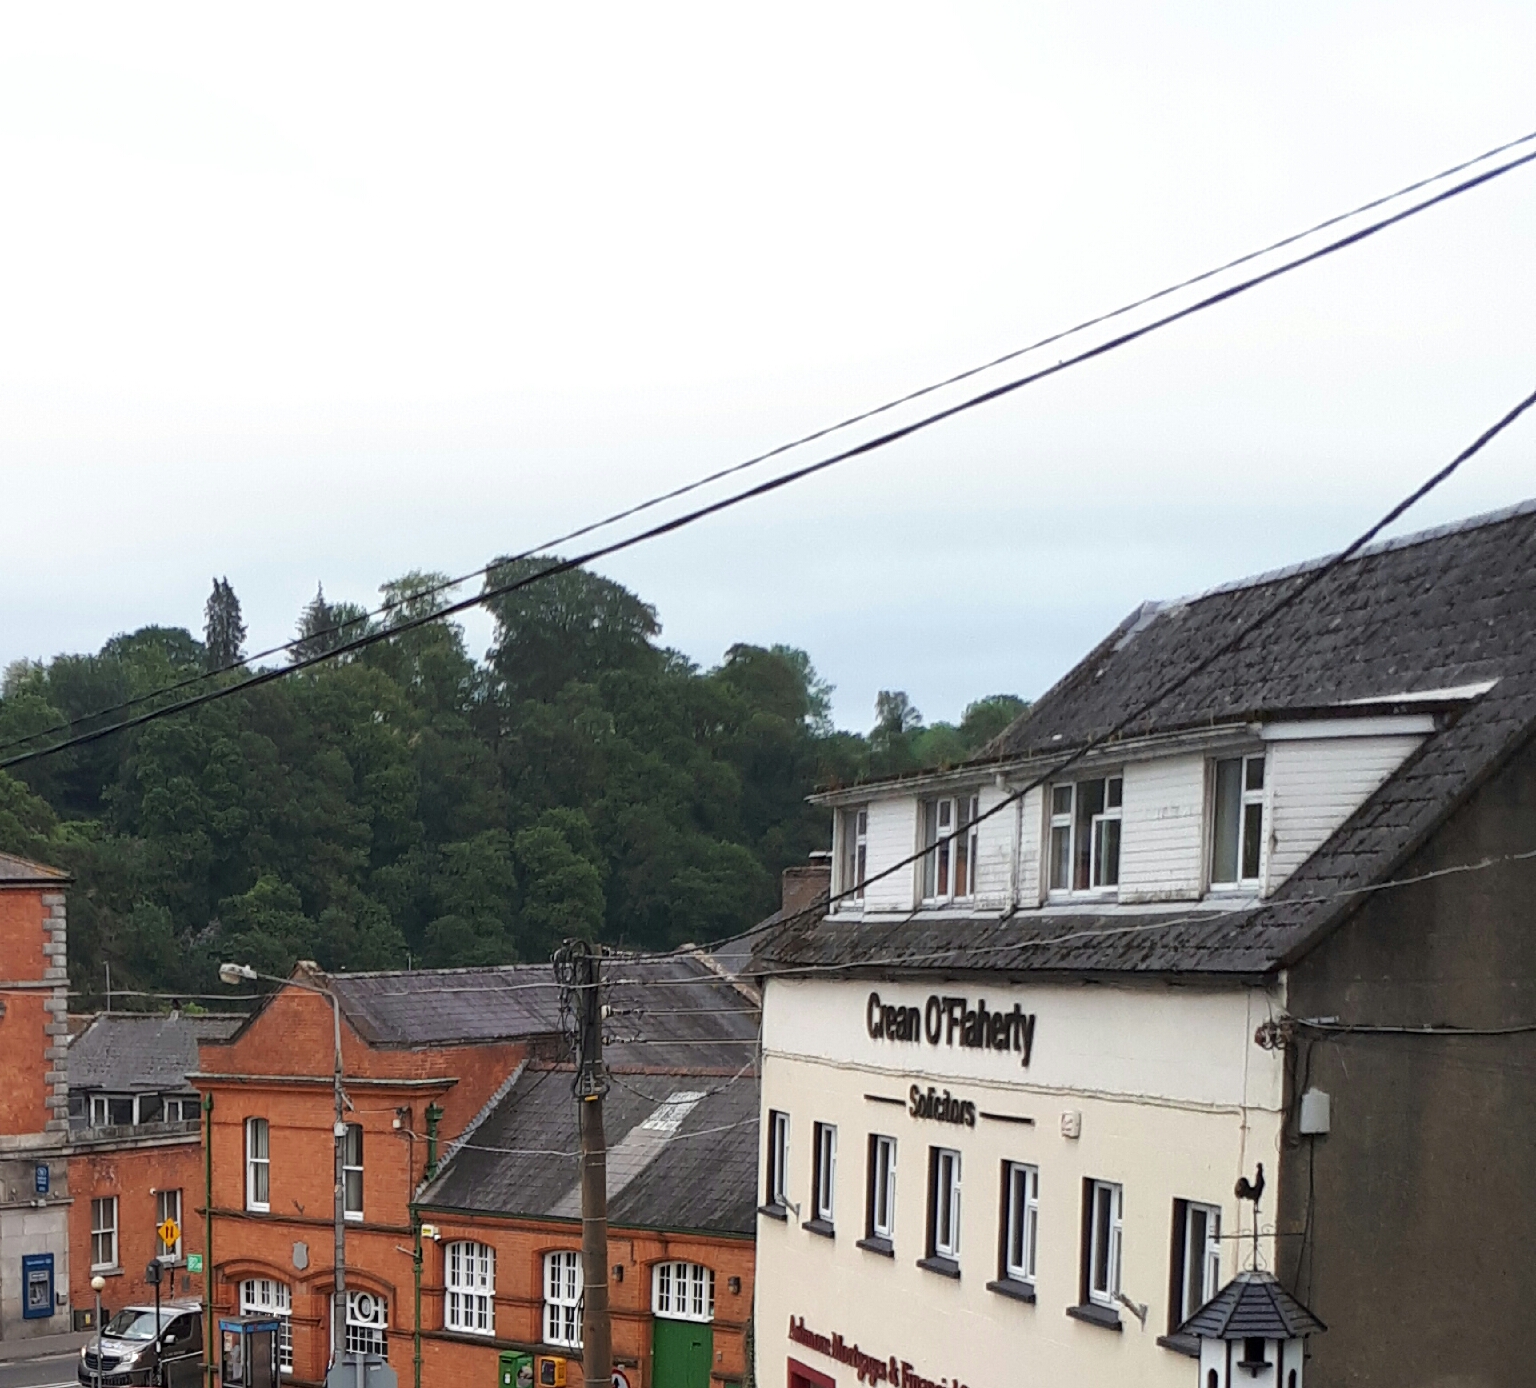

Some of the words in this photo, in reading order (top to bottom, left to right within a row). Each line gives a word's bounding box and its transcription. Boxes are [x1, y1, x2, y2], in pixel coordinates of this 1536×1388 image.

[867, 992, 921, 1043] Crean
[925, 995, 1037, 1068] O'Flaherty
[909, 1083, 977, 1128] Solicitors
[831, 1331, 888, 1388] Mortgages
[888, 1356, 900, 1388] &
